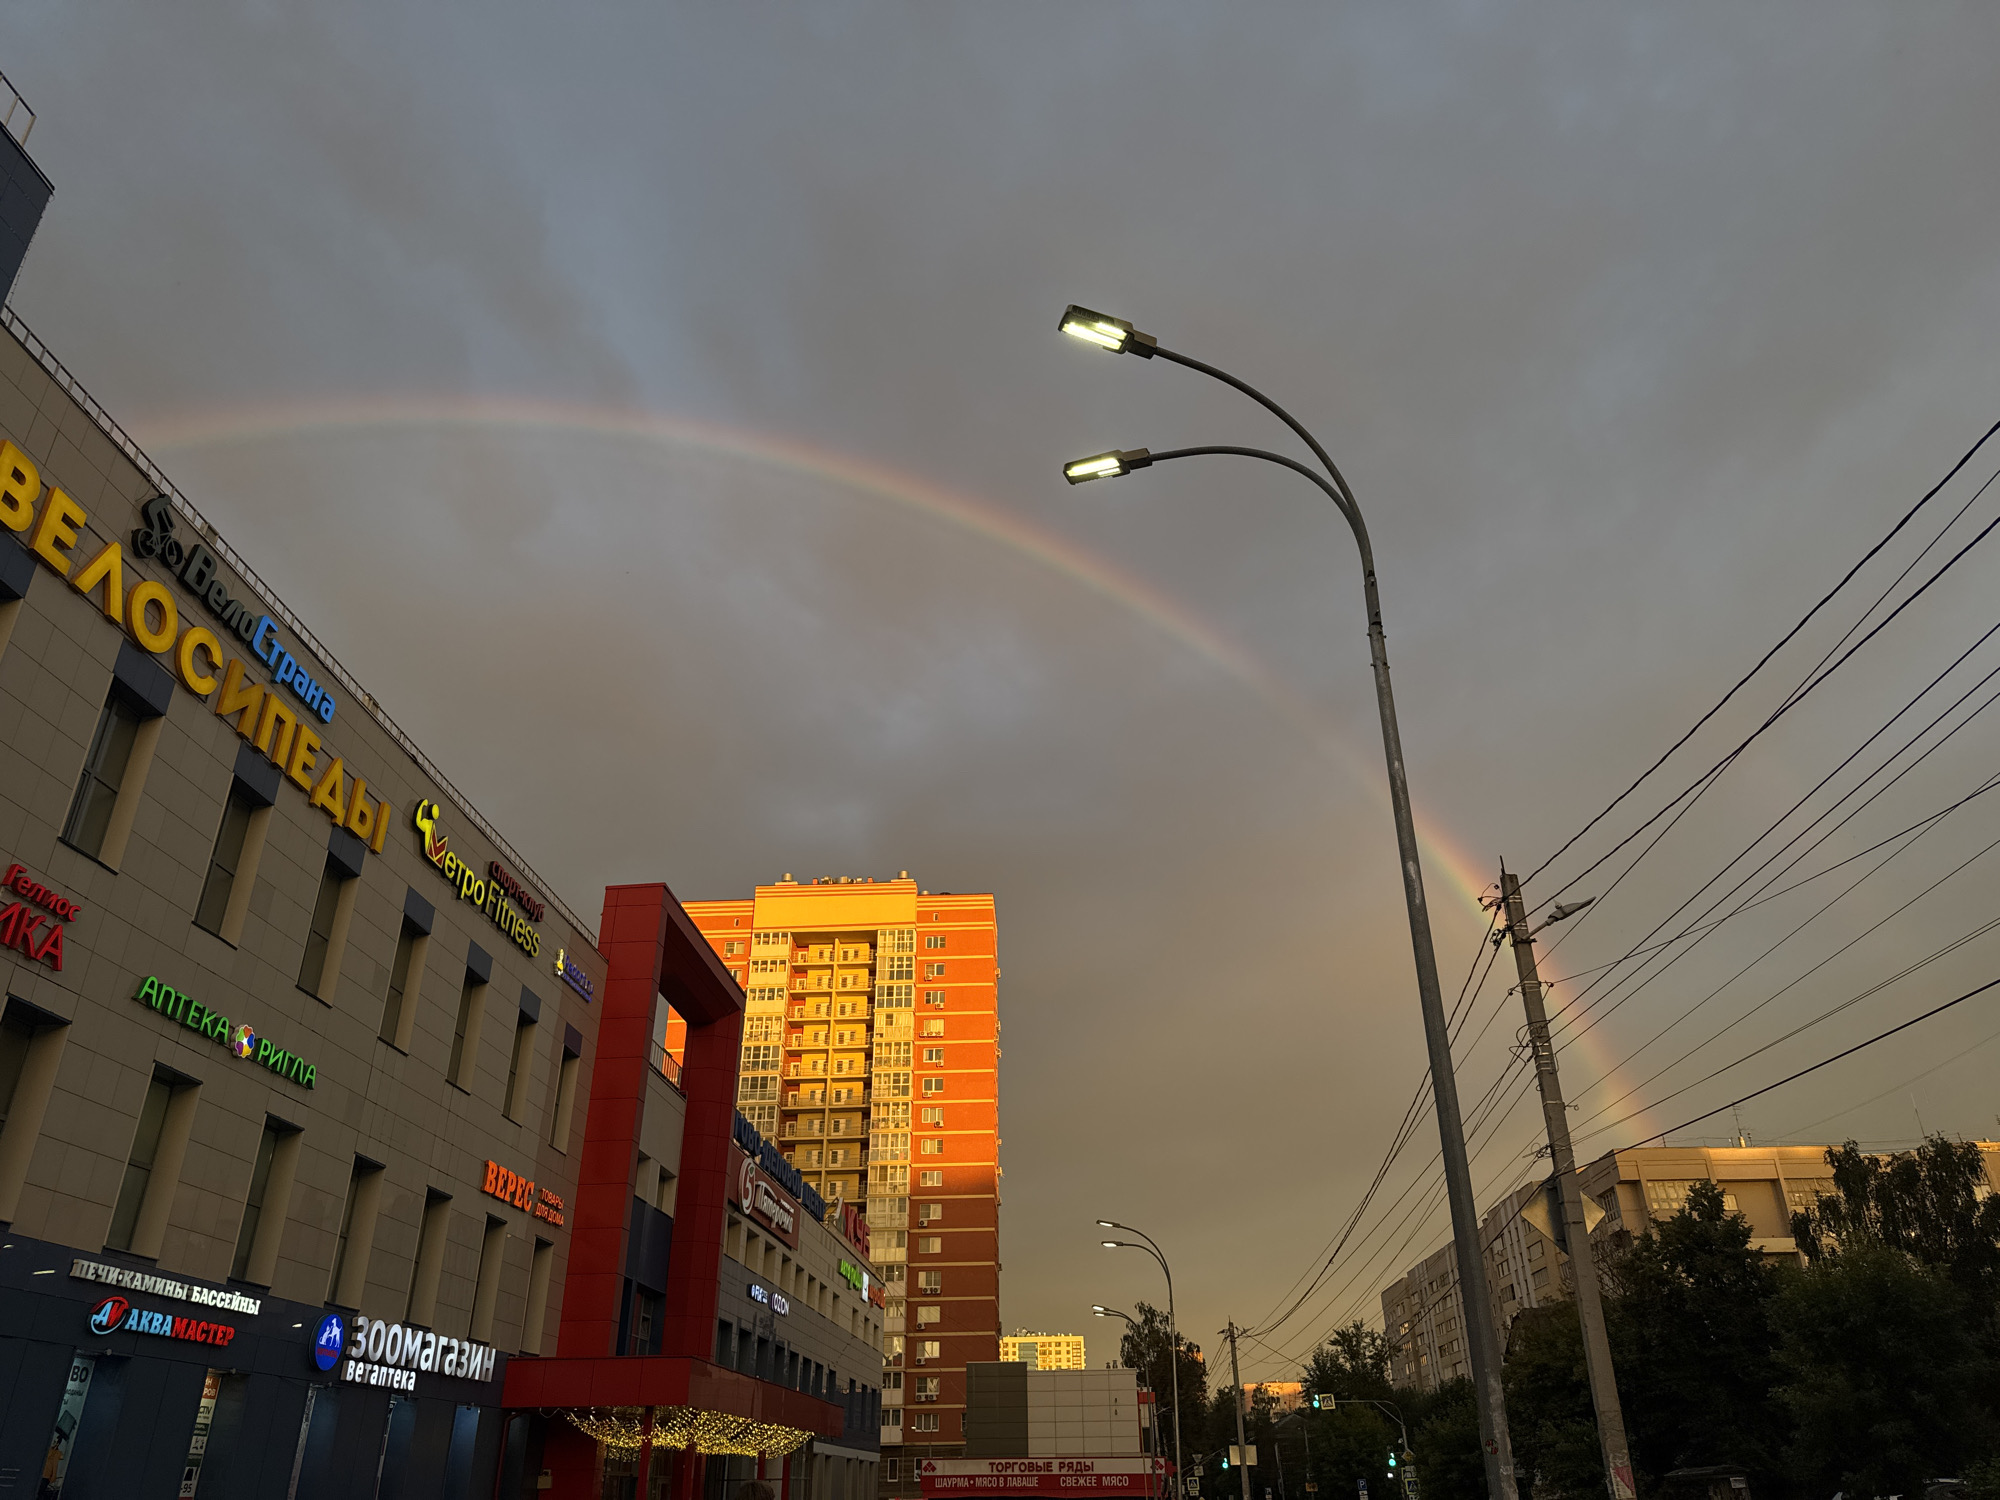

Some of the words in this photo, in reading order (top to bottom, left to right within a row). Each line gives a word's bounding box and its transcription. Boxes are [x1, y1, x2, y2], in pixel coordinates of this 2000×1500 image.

[0, 439, 391, 855] ВЕЛОСИПЕДЫ
[180, 543, 337, 724] ВелоСтрана
[1, 863, 82, 923] Гелиос
[490, 861, 546, 922] спорт-клуб
[134, 975, 230, 1044] АПТЕКА
[256, 1037, 317, 1090] РИГЛА
[482, 1160, 535, 1212] ВЕРЕС
[540, 1188, 565, 1210] ТОВАРЫ
[535, 1203, 549, 1219] ДЛЯ
[548, 1210, 565, 1227] ДОМА
[190, 1285, 262, 1315] БАССЕЙНЫ
[124, 1309, 236, 1347] АКВАМАСТЕР
[342, 1360, 416, 1391] ветаптека
[934, 1477, 969, 1488] ШАУРМА
[975, 1477, 998, 1488] МЯСО
[999, 1477, 1005, 1488] В
[1006, 1476, 1039, 1487] ЛАВАШЕ
[1060, 1476, 1098, 1487] СВЕЖЕЕ
[1102, 1475, 1129, 1487] МЯСО
[988, 1461, 1053, 1473] ТОРГОВЫЕ
[1058, 1460, 1095, 1473] РЯДЫ
